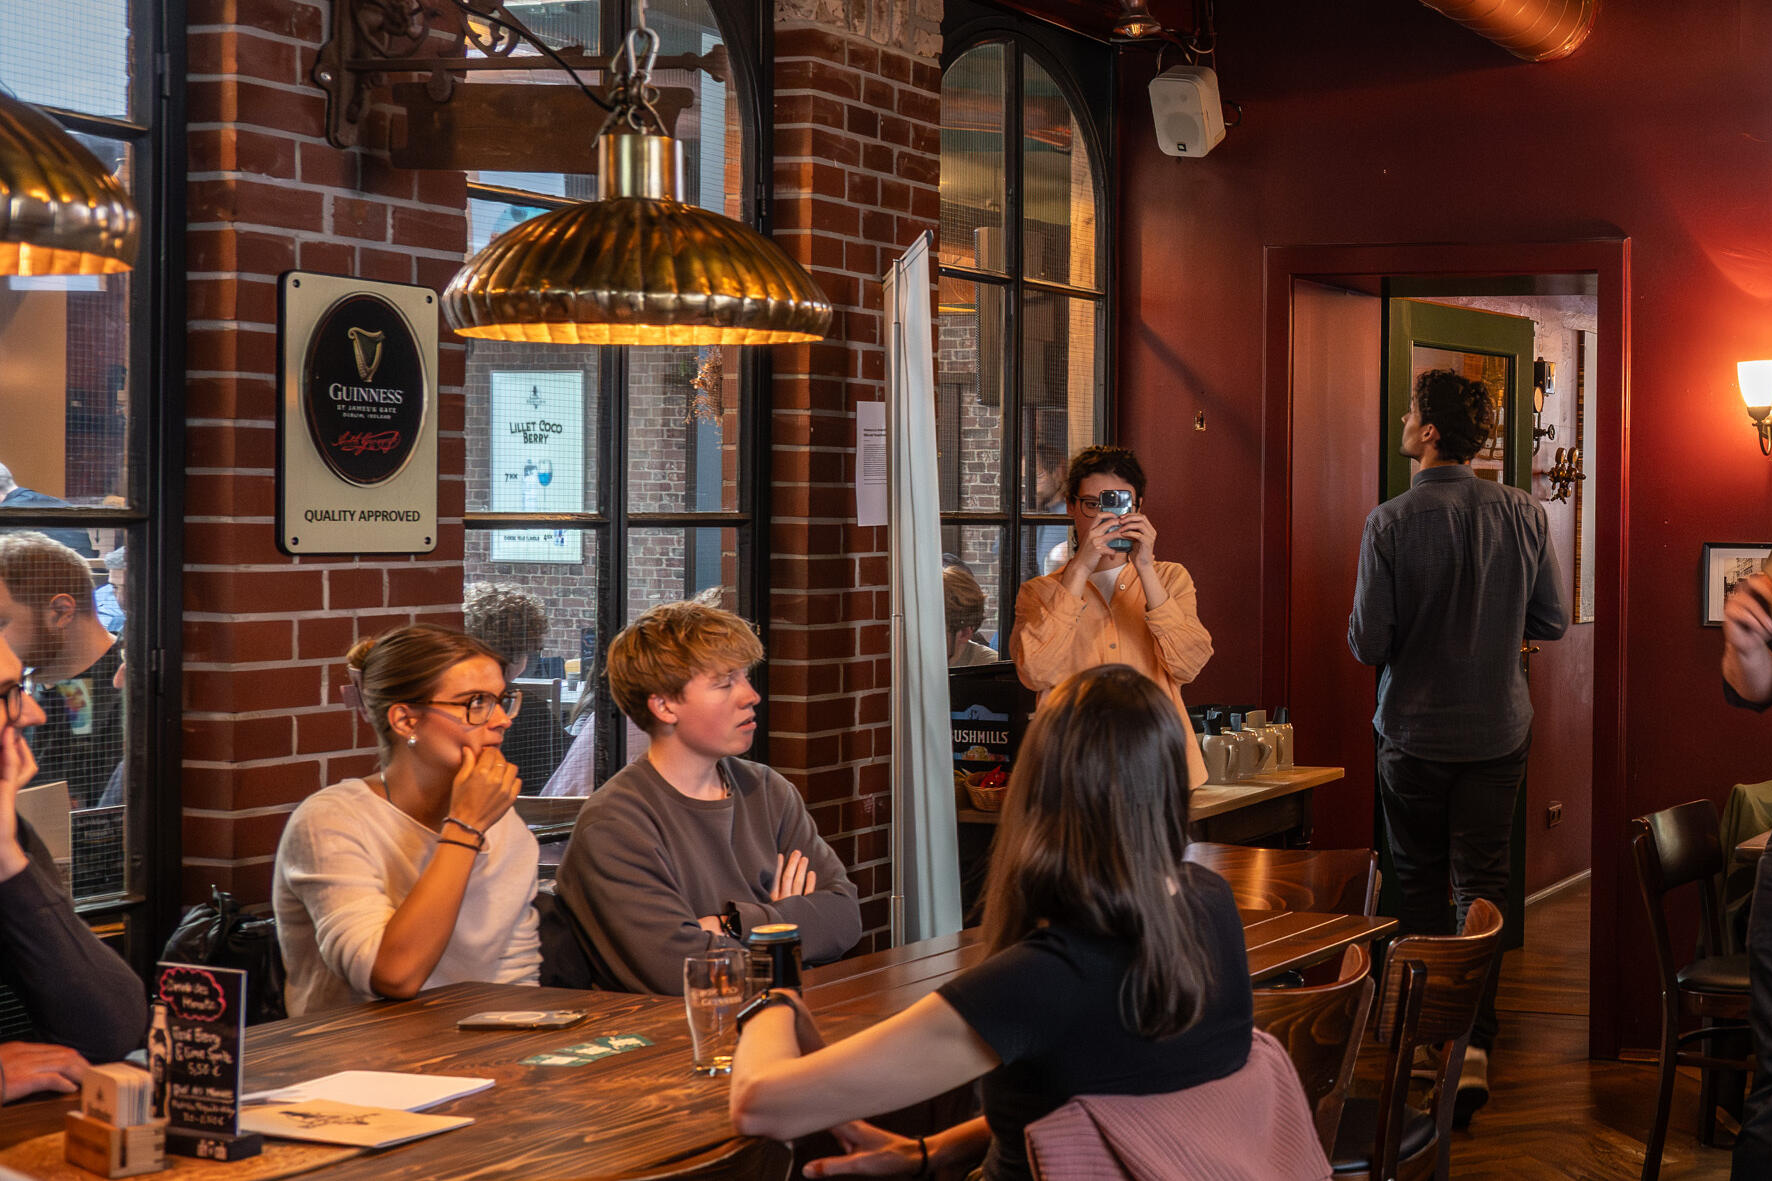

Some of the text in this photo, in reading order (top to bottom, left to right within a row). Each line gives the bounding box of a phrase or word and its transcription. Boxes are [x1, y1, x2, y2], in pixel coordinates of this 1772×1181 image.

[329, 382, 404, 404] GUINNESS
[509, 419, 563, 434] LILLET COCO
[523, 432, 549, 445] BERRY
[304, 509, 421, 523] QUALITY APPROVED
[952, 729, 1009, 744] USHMILLS
